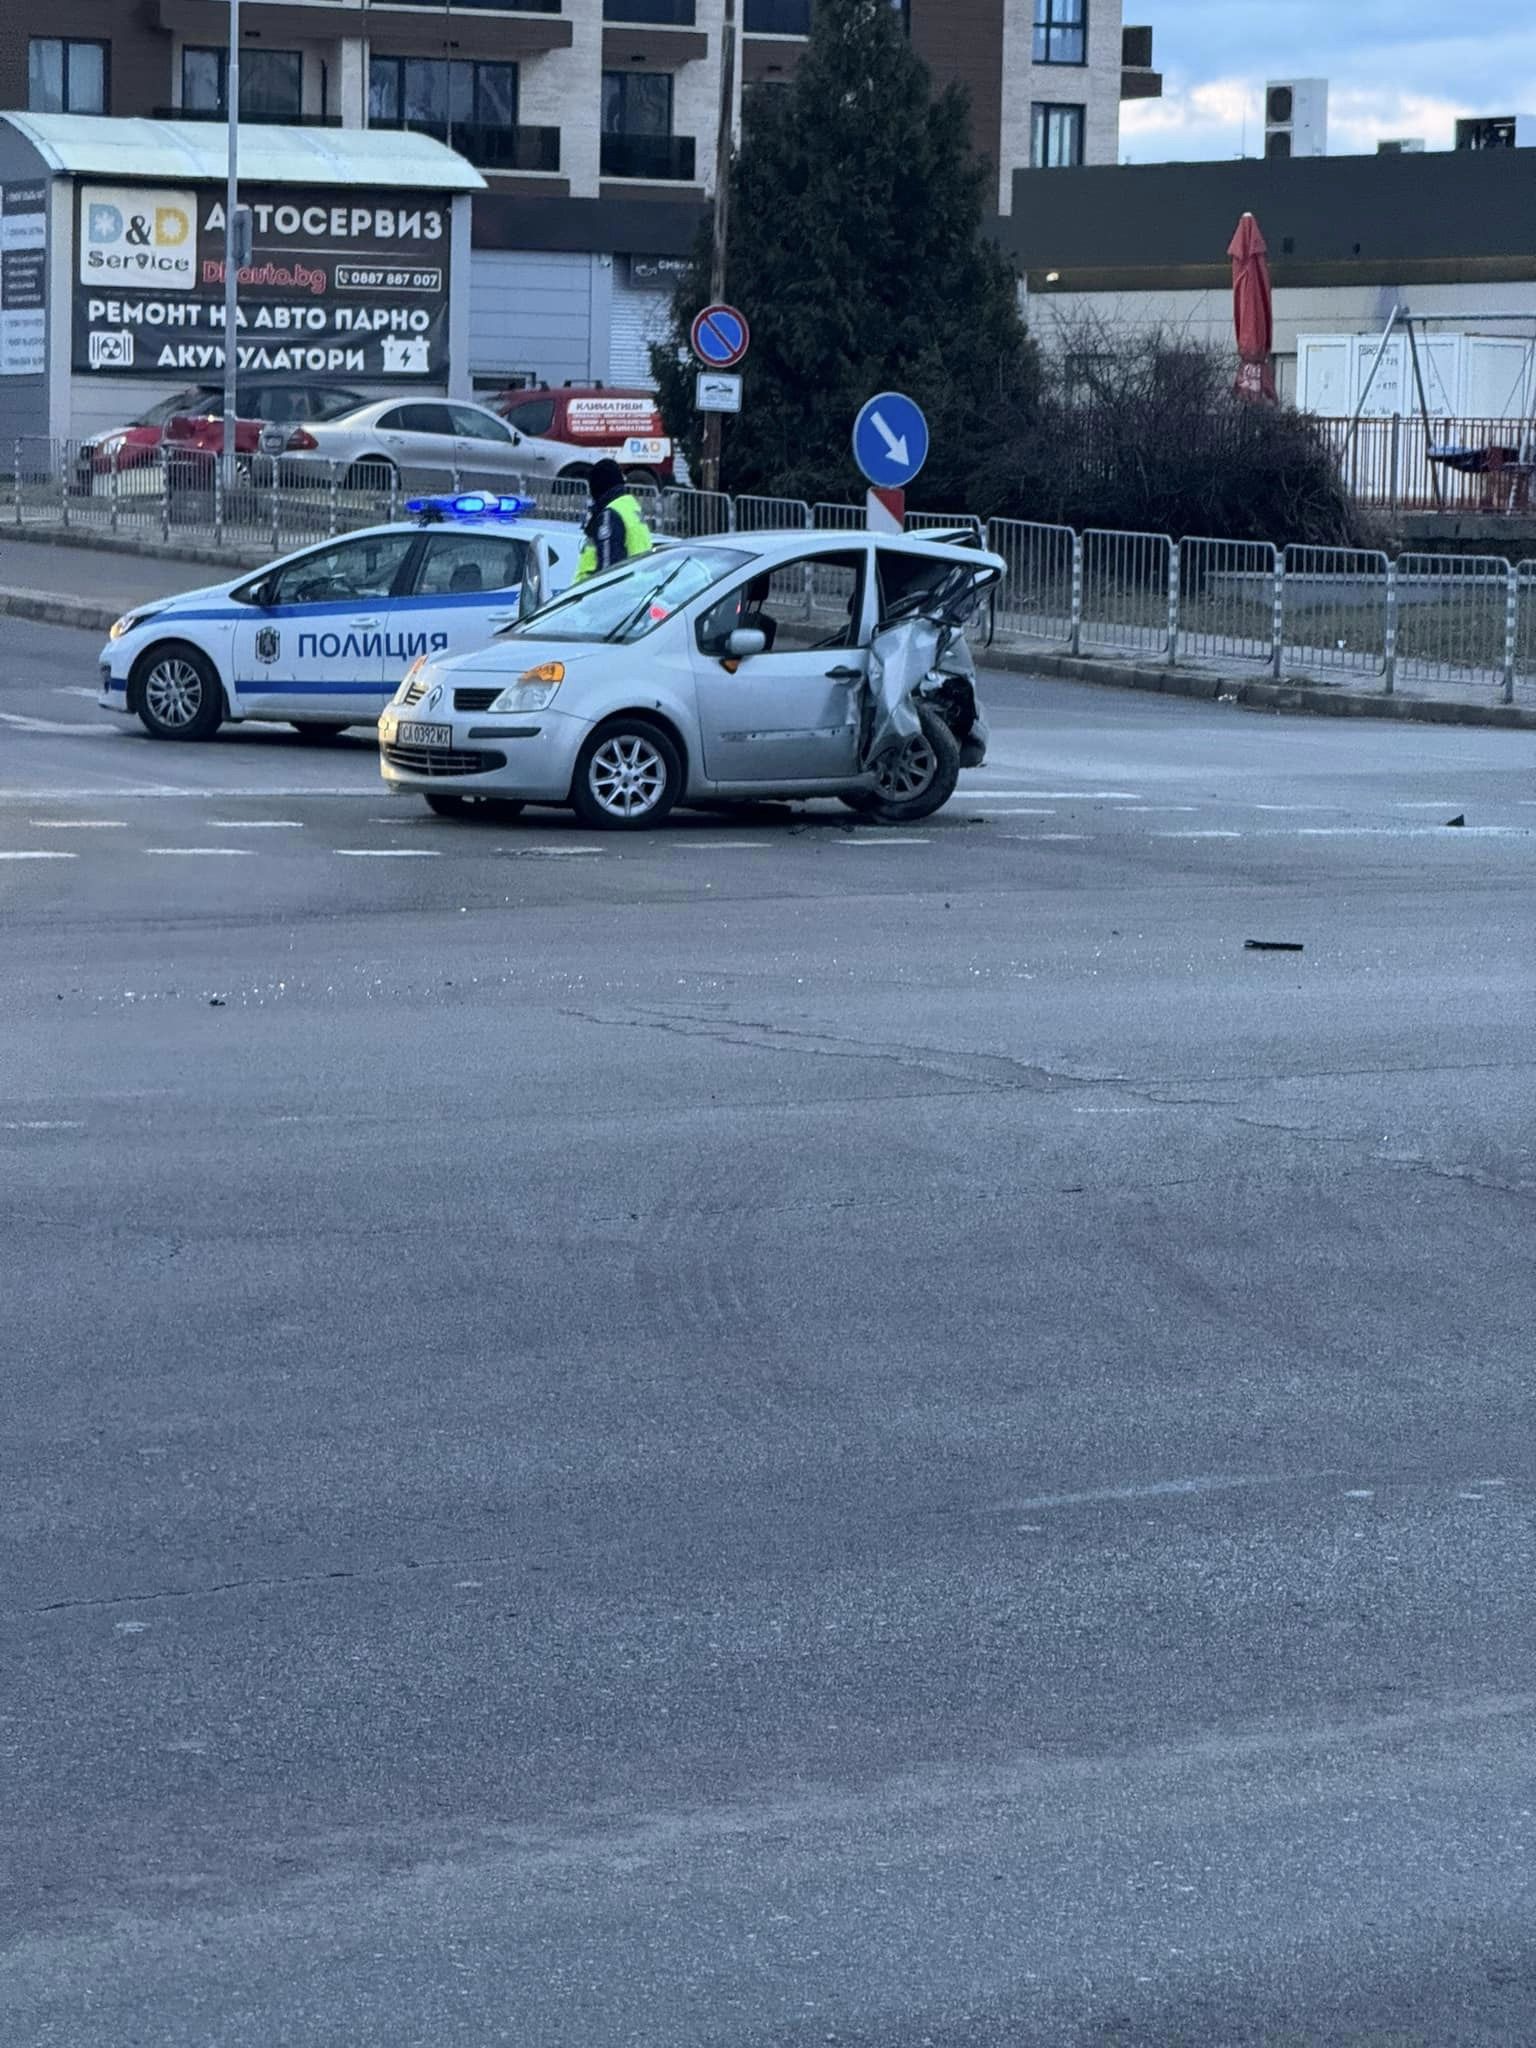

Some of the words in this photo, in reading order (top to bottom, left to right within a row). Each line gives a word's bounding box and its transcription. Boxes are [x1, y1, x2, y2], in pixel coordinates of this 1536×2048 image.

[88, 203, 190, 247] D&D
[204, 202, 443, 240] АТОСЕРВИЗ
[87, 250, 190, 272] Service
[351, 273, 383, 285] 0887
[386, 274, 410, 286] 887
[413, 275, 438, 287] 007
[88, 300, 202, 326] РЕМОНТ
[254, 306, 327, 330] АВТО
[334, 308, 430, 332] ПАРНО
[298, 632, 448, 661] ПОЛИЦИЯ
